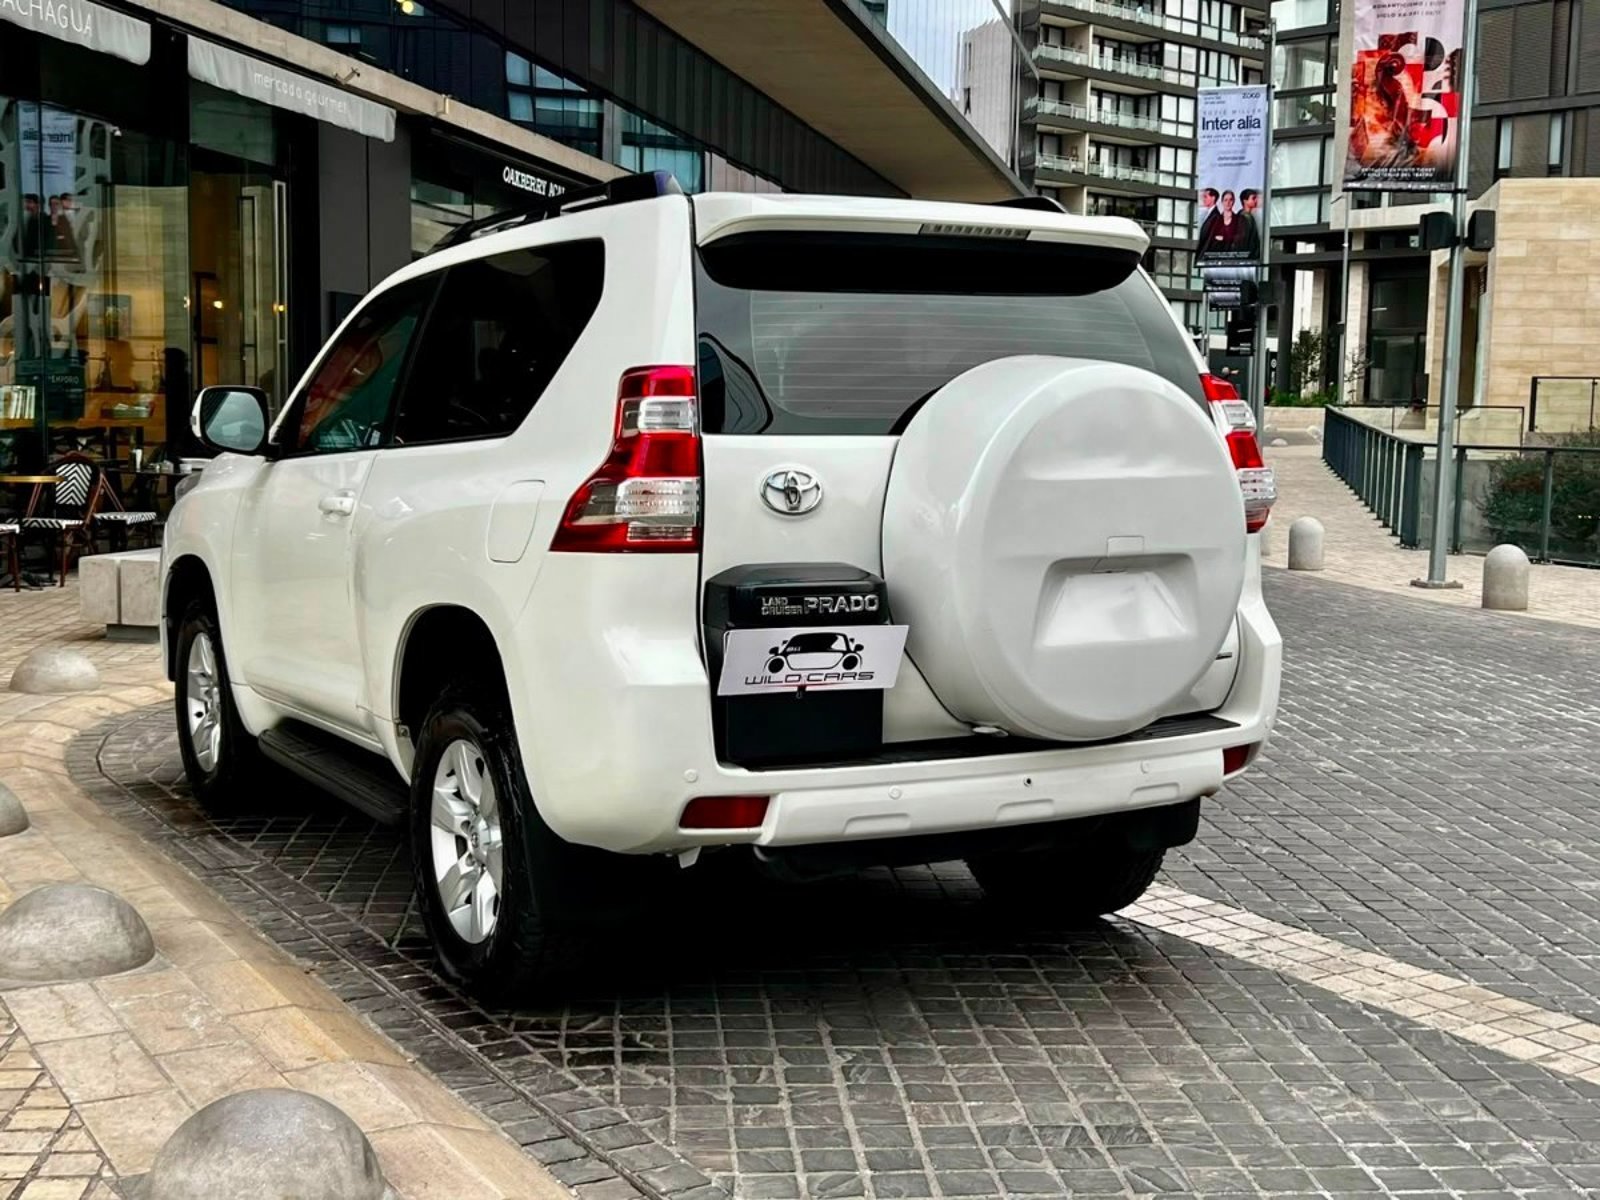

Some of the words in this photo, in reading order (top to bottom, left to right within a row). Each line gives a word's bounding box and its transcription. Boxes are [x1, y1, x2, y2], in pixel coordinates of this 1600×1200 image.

[254, 73, 302, 99] mercado
[305, 90, 347, 113] gourmet
[1202, 117, 1235, 131] Inter
[1237, 115, 1261, 129] alia
[503, 166, 548, 196] OAKBERRY
[762, 597, 788, 606] LAND
[804, 594, 879, 614] PRADO
[761, 605, 803, 615] CRUISER
[745, 675, 802, 685] WILD
[806, 671, 875, 682] CARS
